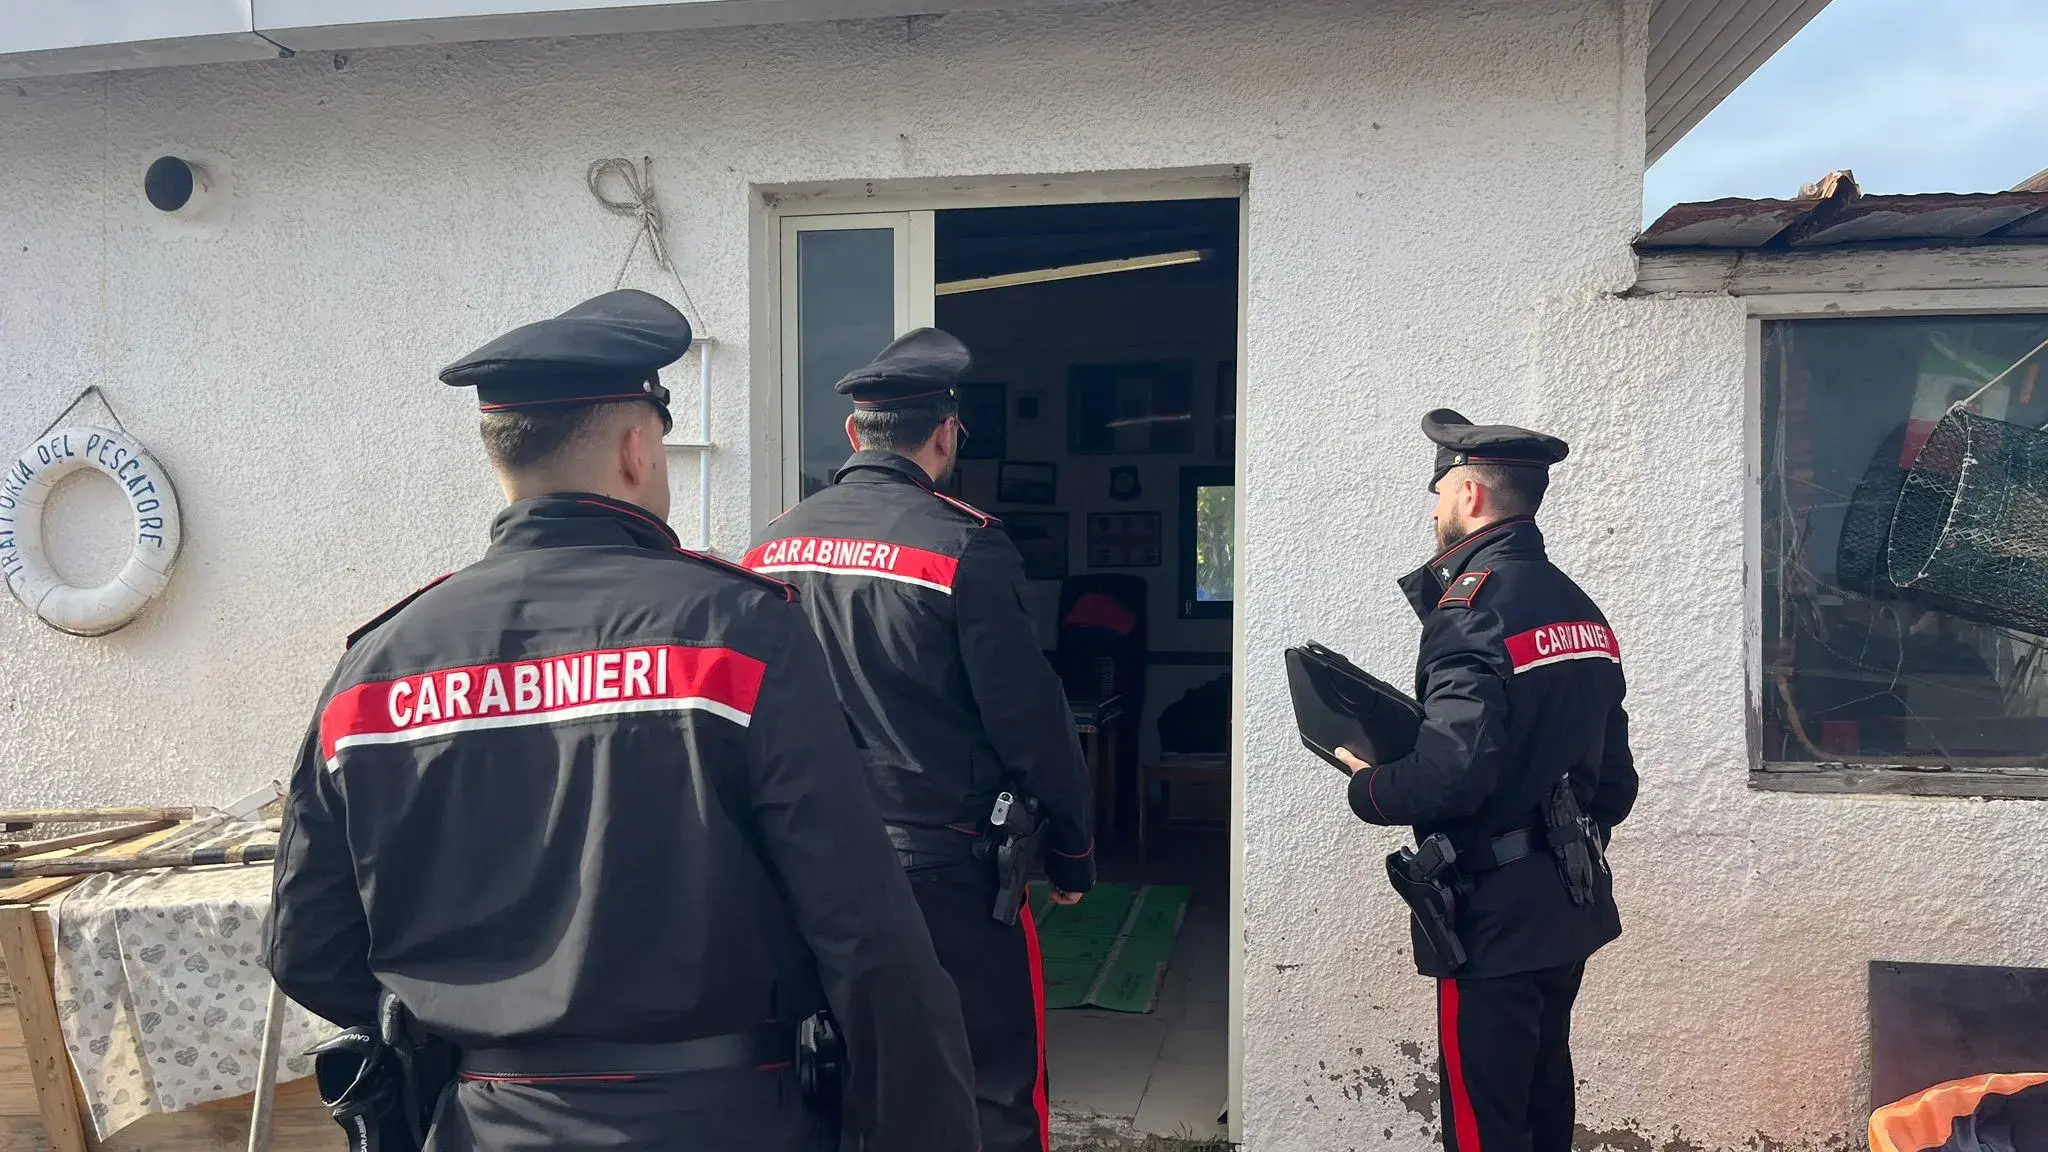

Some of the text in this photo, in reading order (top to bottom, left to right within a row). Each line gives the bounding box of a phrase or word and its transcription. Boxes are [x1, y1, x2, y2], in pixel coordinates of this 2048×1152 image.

[37, 434, 74, 465] DEL
[86, 434, 163, 549] PESCATORE
[763, 539, 901, 570] CARABINIERI
[388, 647, 668, 728] CARABINIERI
